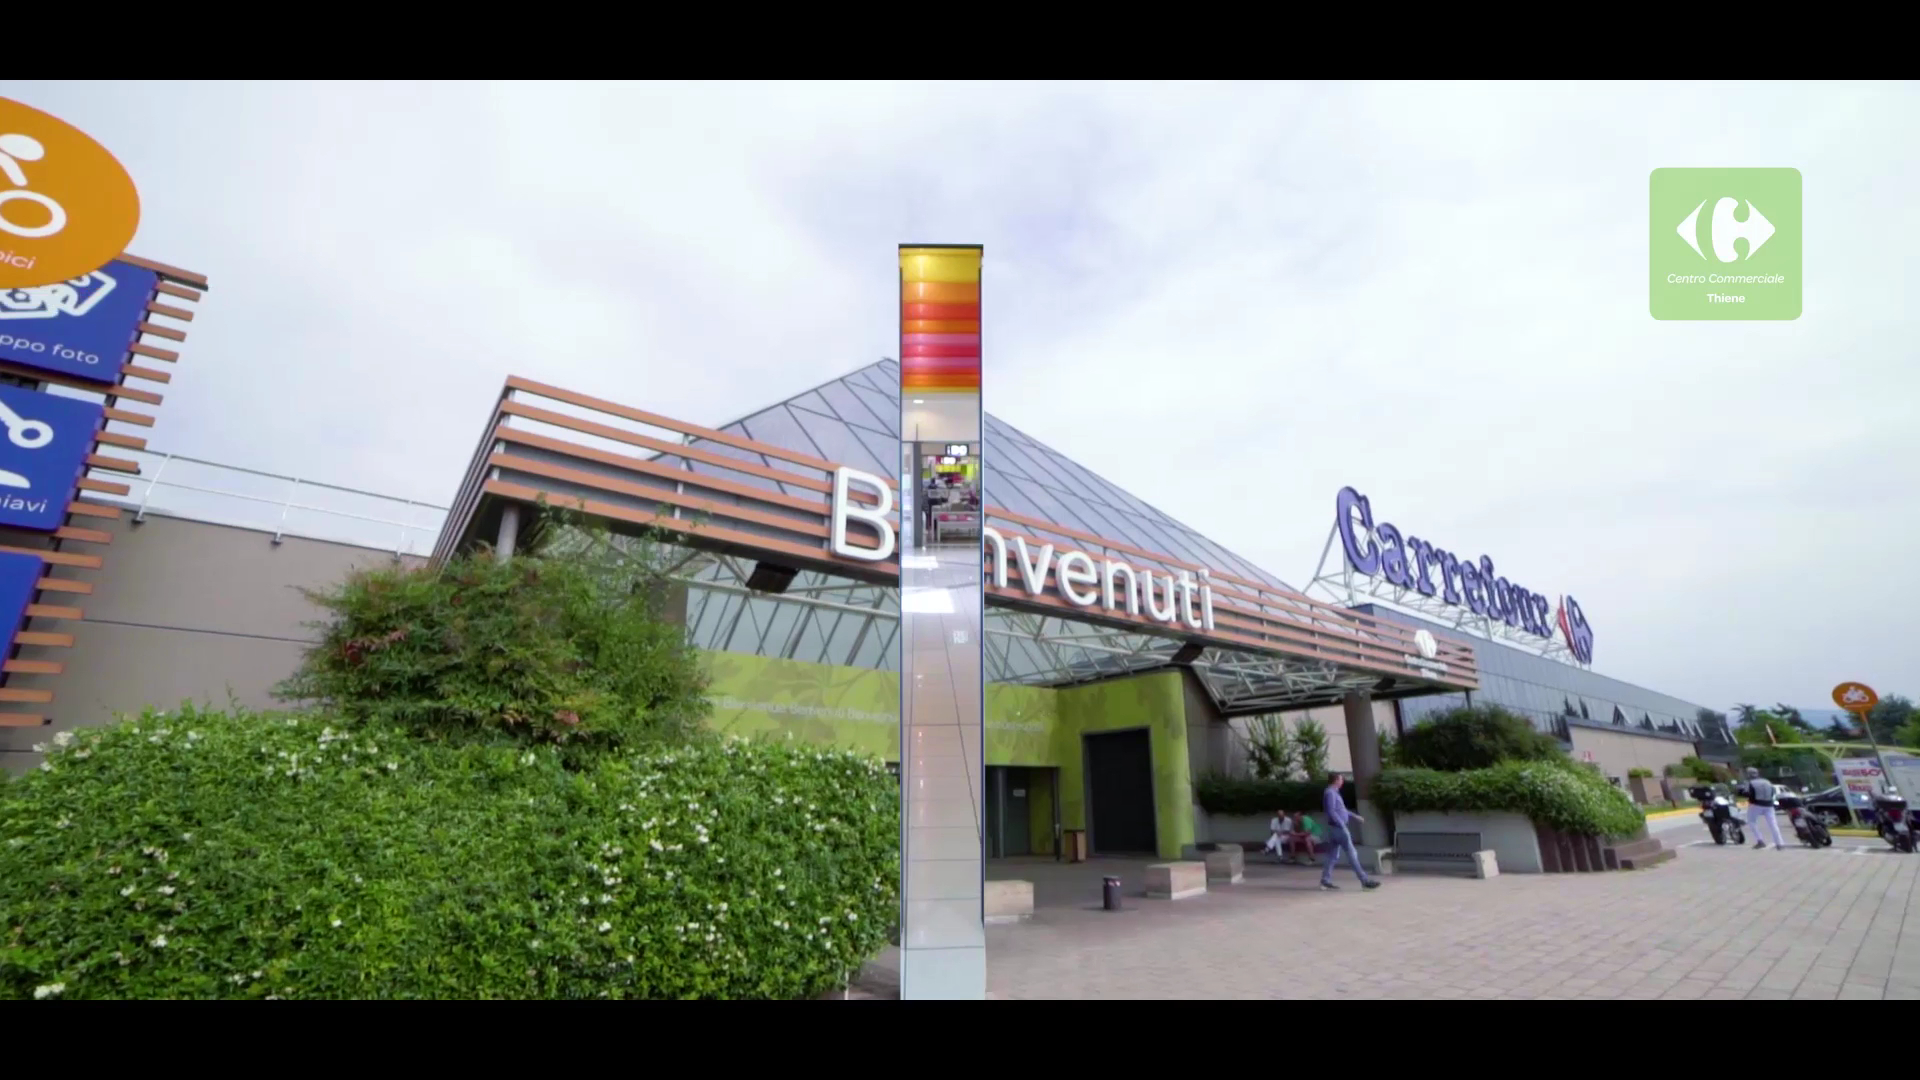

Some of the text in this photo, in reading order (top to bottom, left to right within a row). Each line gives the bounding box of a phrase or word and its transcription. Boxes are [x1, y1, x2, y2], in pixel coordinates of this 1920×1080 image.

[52, 343, 99, 365] foto
[0, 493, 48, 513] iavi
[830, 465, 1214, 631] Bnvenuti
[1336, 485, 1551, 639] Carrefour
